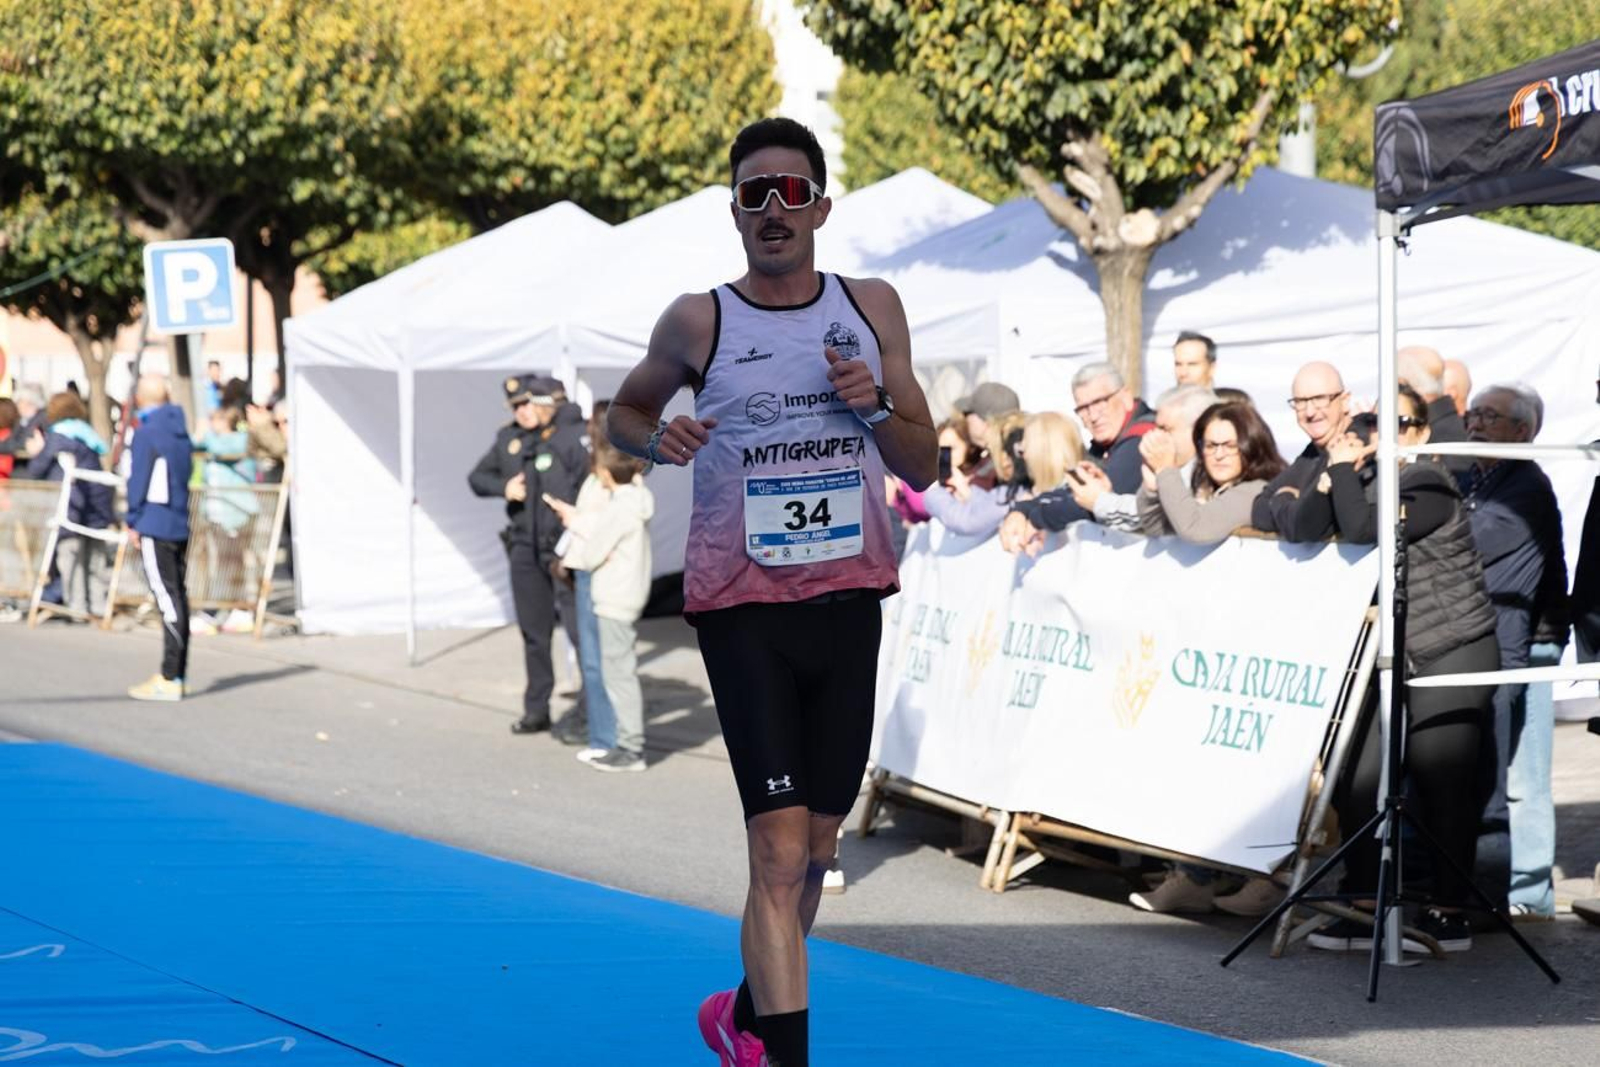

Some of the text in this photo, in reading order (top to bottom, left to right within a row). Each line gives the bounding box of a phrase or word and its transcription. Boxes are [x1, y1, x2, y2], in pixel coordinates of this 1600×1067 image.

[163, 251, 218, 323] P
[784, 391, 847, 409] Impor
[784, 498, 832, 531] 34
[785, 533, 809, 541] PEDRO
[1172, 648, 1328, 708] CAJA RURAL
[1200, 702, 1274, 753] JAÉN
